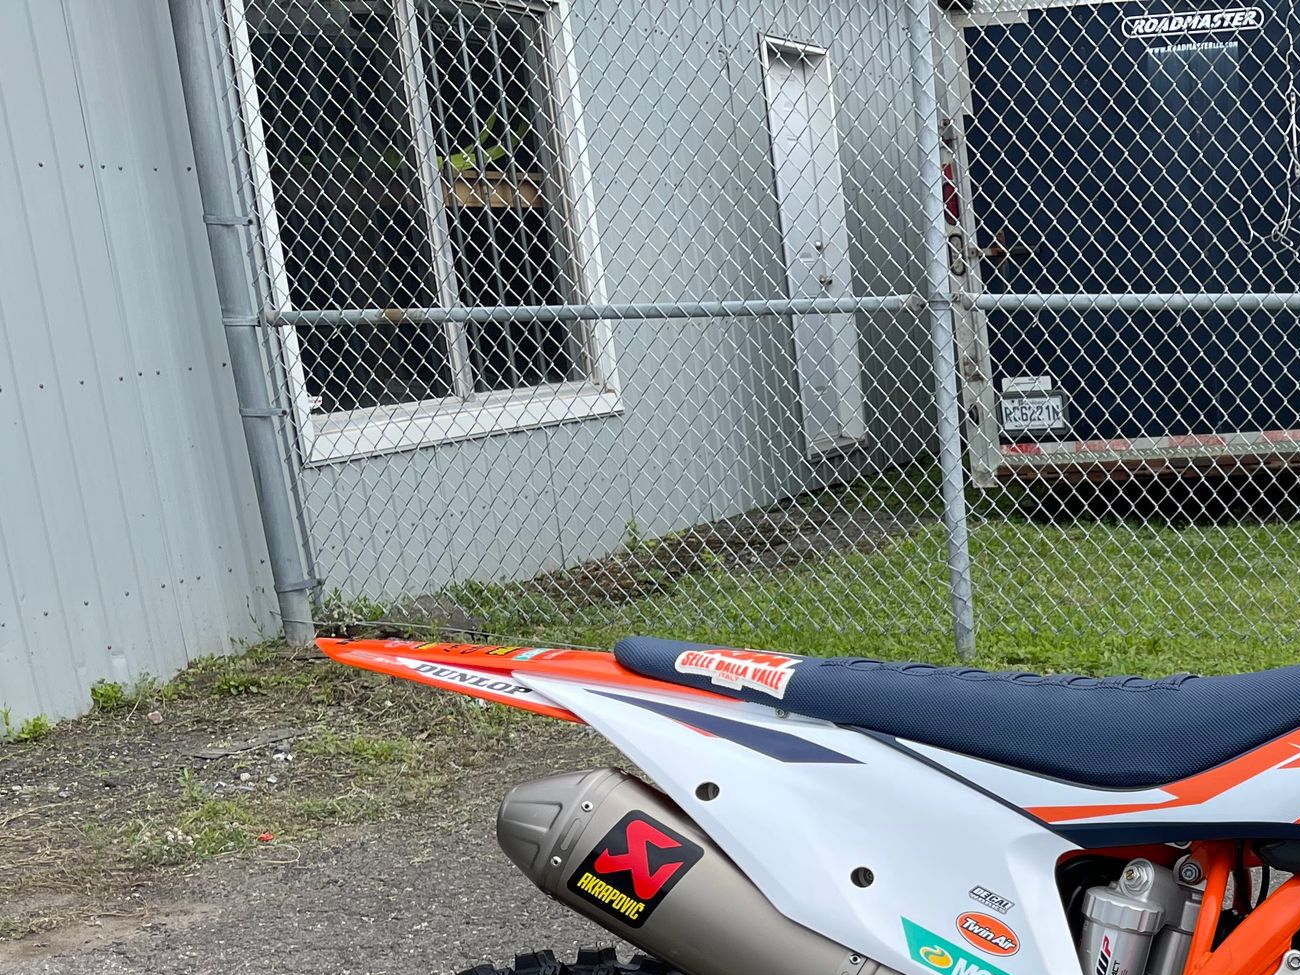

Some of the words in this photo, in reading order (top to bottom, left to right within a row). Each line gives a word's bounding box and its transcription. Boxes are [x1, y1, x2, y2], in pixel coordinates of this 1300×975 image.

[1132, 10, 1257, 34] ROADMASTER
[413, 663, 533, 694] DUNLOP
[681, 652, 715, 669] SELLE
[715, 660, 749, 679] DALLA
[751, 667, 785, 690] VALLE
[718, 672, 740, 682] ITALY
[972, 886, 1013, 909] DECAL
[962, 917, 995, 941] Twin
[992, 934, 1016, 951] Air
